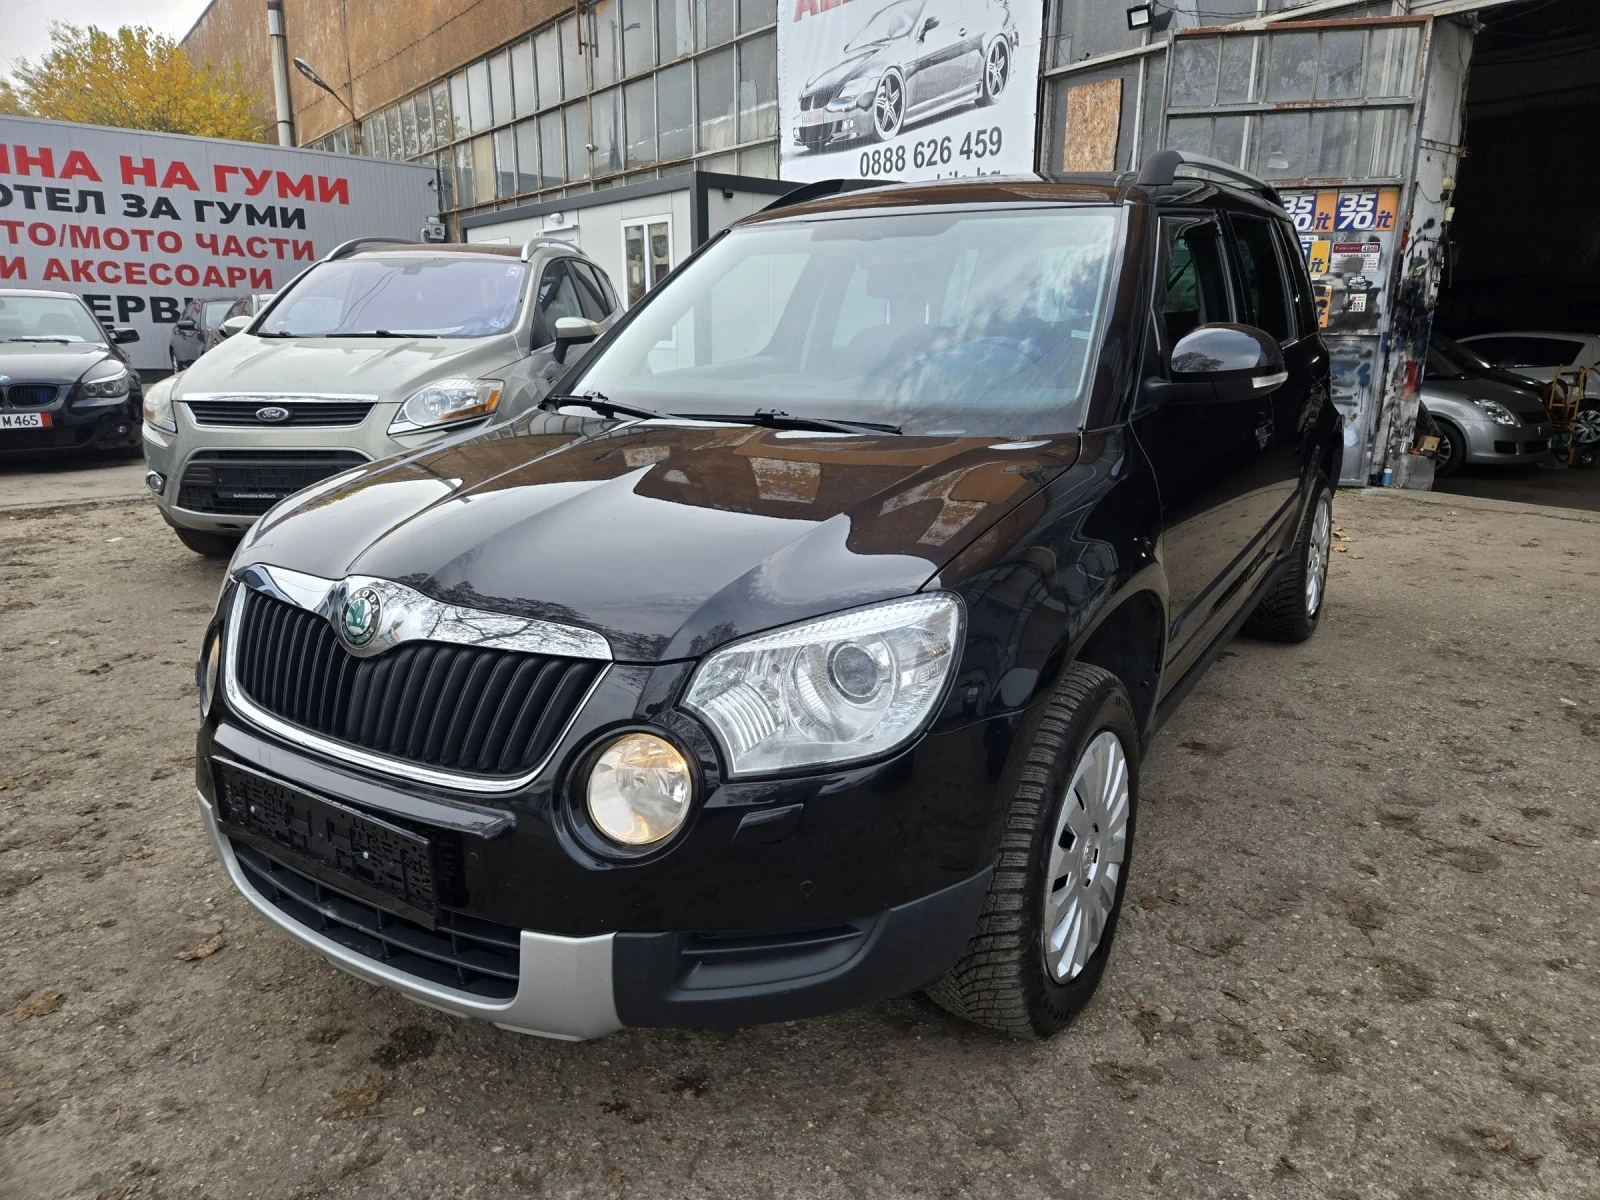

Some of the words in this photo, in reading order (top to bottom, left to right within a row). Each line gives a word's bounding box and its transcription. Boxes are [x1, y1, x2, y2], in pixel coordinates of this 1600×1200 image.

[860, 145, 906, 177] 0888
[913, 136, 953, 169] 626
[959, 126, 1003, 161] 459
[119, 155, 200, 191] НА
[214, 164, 349, 205] ГУМИ
[121, 193, 181, 220] ЗА
[194, 199, 306, 230] ГУМИ
[1283, 196, 1315, 214] 35
[1340, 193, 1376, 212] 35
[195, 233, 315, 261] ЧАСТИ
[42, 258, 273, 290] АКСЕСОАРИ
[82, 294, 194, 324] ЕРВ
[2, 415, 12, 427] M
[14, 415, 39, 427] 465
[262, 409, 281, 418] Ford
